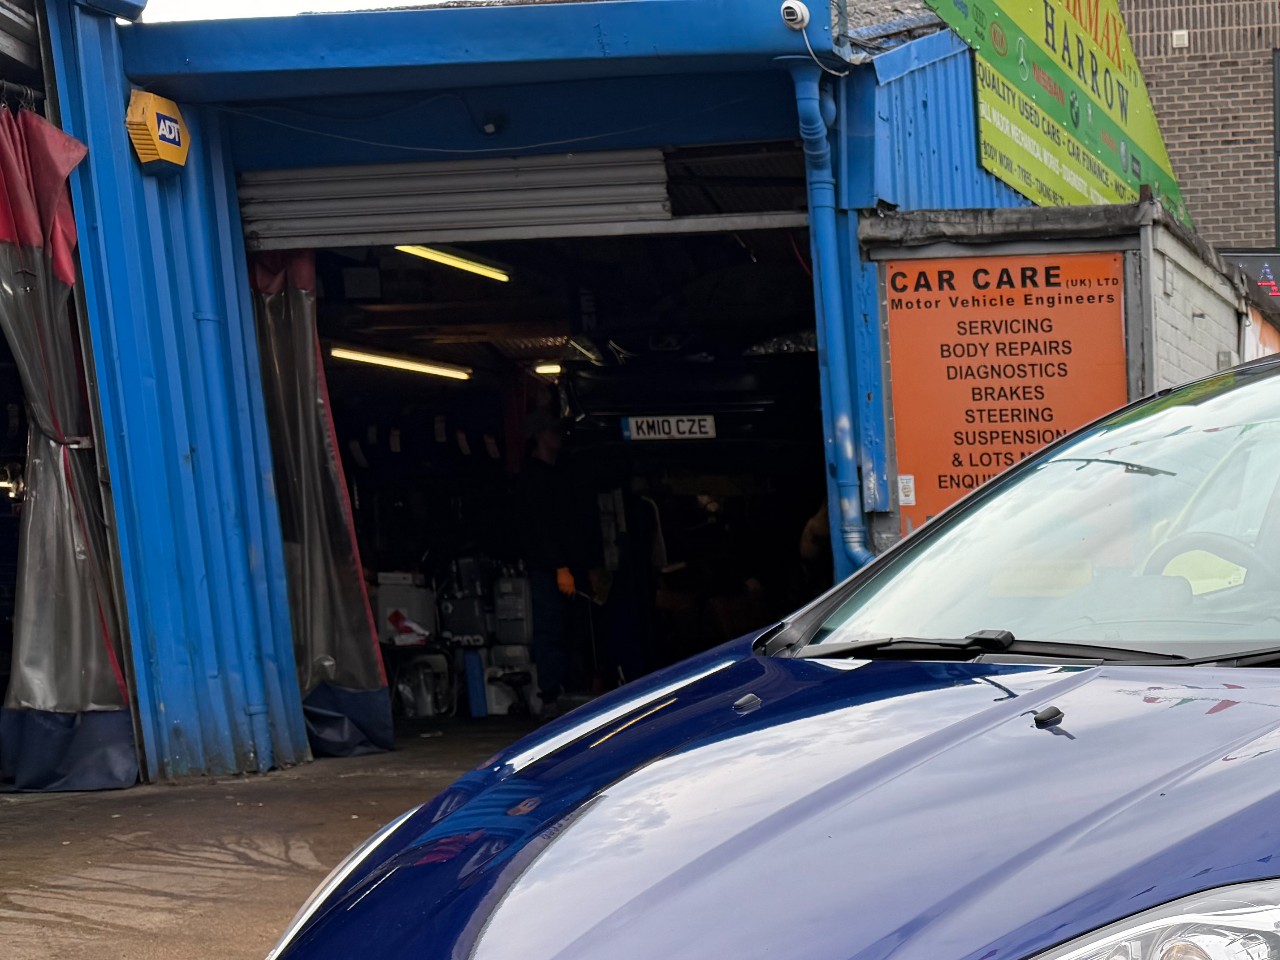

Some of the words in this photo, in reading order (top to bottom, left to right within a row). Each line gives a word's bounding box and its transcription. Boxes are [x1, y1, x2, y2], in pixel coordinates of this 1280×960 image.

[1043, 0, 1129, 127] HARROW
[977, 62, 1017, 110] QUALITY
[1018, 94, 1040, 128] USED
[1041, 116, 1062, 146] CARS
[158, 119, 180, 142] ADT
[890, 270, 956, 293] CAR
[972, 266, 1062, 290] CARE
[1065, 279, 1092, 289] (UK)
[1097, 277, 1119, 287] LTD
[891, 298, 941, 311] Motor
[949, 294, 1015, 309] Vehicle
[1024, 292, 1115, 308] Engineers
[956, 318, 1053, 336] SERVICING
[940, 342, 989, 359] BODY
[996, 340, 1072, 357] REPAIRS
[946, 362, 1068, 380] DIAGNOSTICS
[971, 385, 1045, 402] BRAKES
[965, 407, 1054, 423] STEERING
[635, 418, 672, 436] KM10
[676, 418, 709, 435] CZE
[953, 429, 1067, 446] SUSPENSION
[952, 452, 963, 467] &
[969, 452, 1014, 467] LOTS
[938, 474, 998, 489] ENQU
